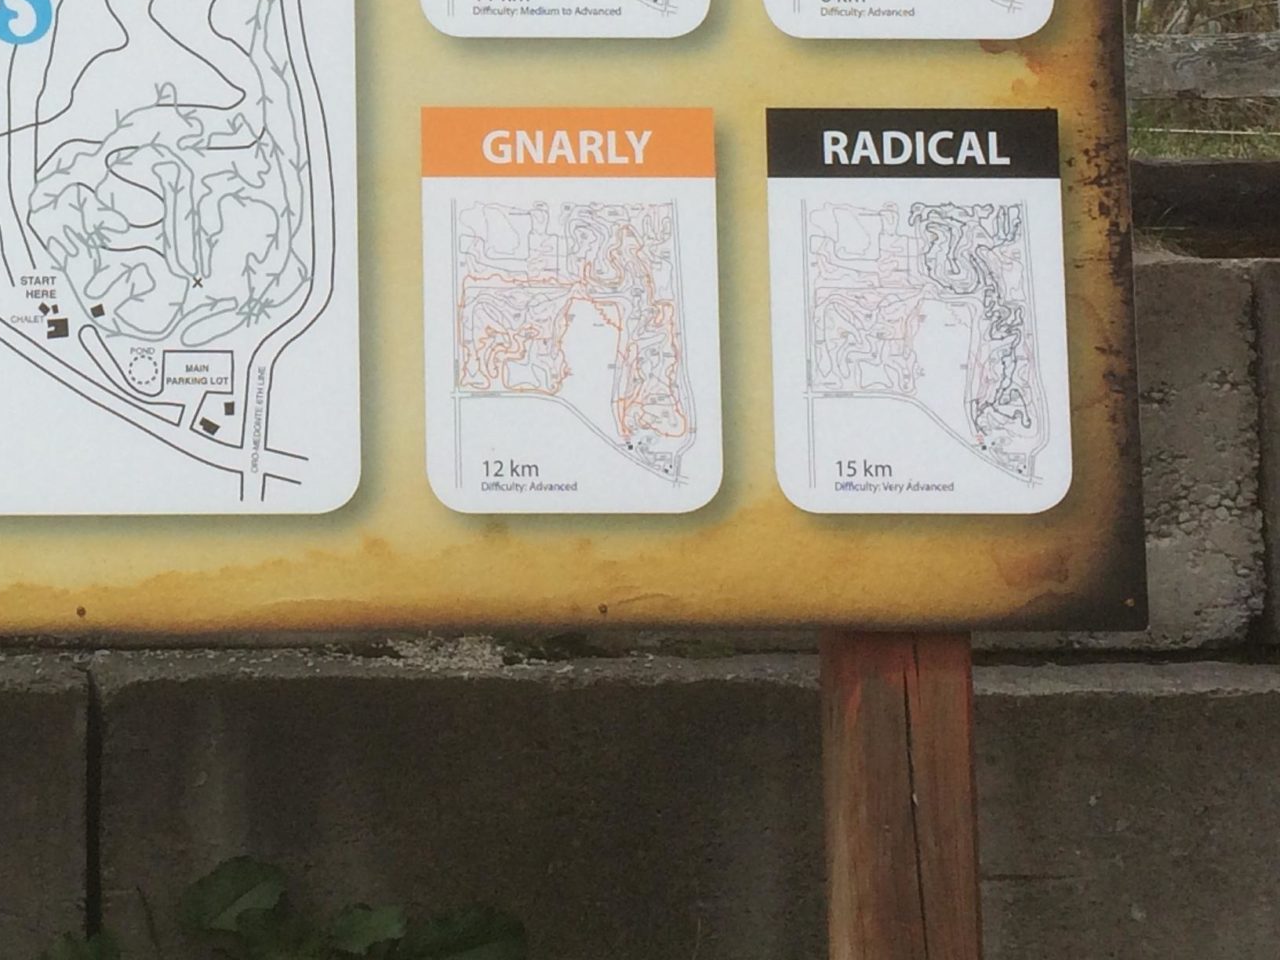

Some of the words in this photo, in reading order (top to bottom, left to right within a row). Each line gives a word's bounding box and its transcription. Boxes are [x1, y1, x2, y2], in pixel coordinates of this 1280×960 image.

[472, 6, 518, 17] Difficulty:
[521, 6, 558, 16] Medium
[561, 6, 571, 16] to
[574, 6, 622, 16] Advanced
[820, 7, 865, 18] Difficulty:
[868, 7, 915, 17] Advanced
[481, 129, 653, 165] GNARLY
[823, 129, 1010, 165] RADICAL
[20, 276, 56, 286] START
[25, 289, 57, 299] HERE
[10, 315, 45, 324] CHALET
[129, 347, 156, 355] POND
[184, 364, 209, 373] MAIN
[165, 376, 208, 385] PARKING
[210, 376, 229, 385] LOT
[256, 366, 267, 388] LINE
[481, 459, 503, 478] 12
[508, 459, 540, 478] km
[835, 459, 856, 478] 15
[862, 459, 893, 478] km
[481, 481, 527, 493] Difficulty:
[530, 480, 579, 492] Advanced
[834, 481, 879, 493] Difficulty:
[882, 481, 903, 493] Very
[905, 481, 955, 492] Advanced
